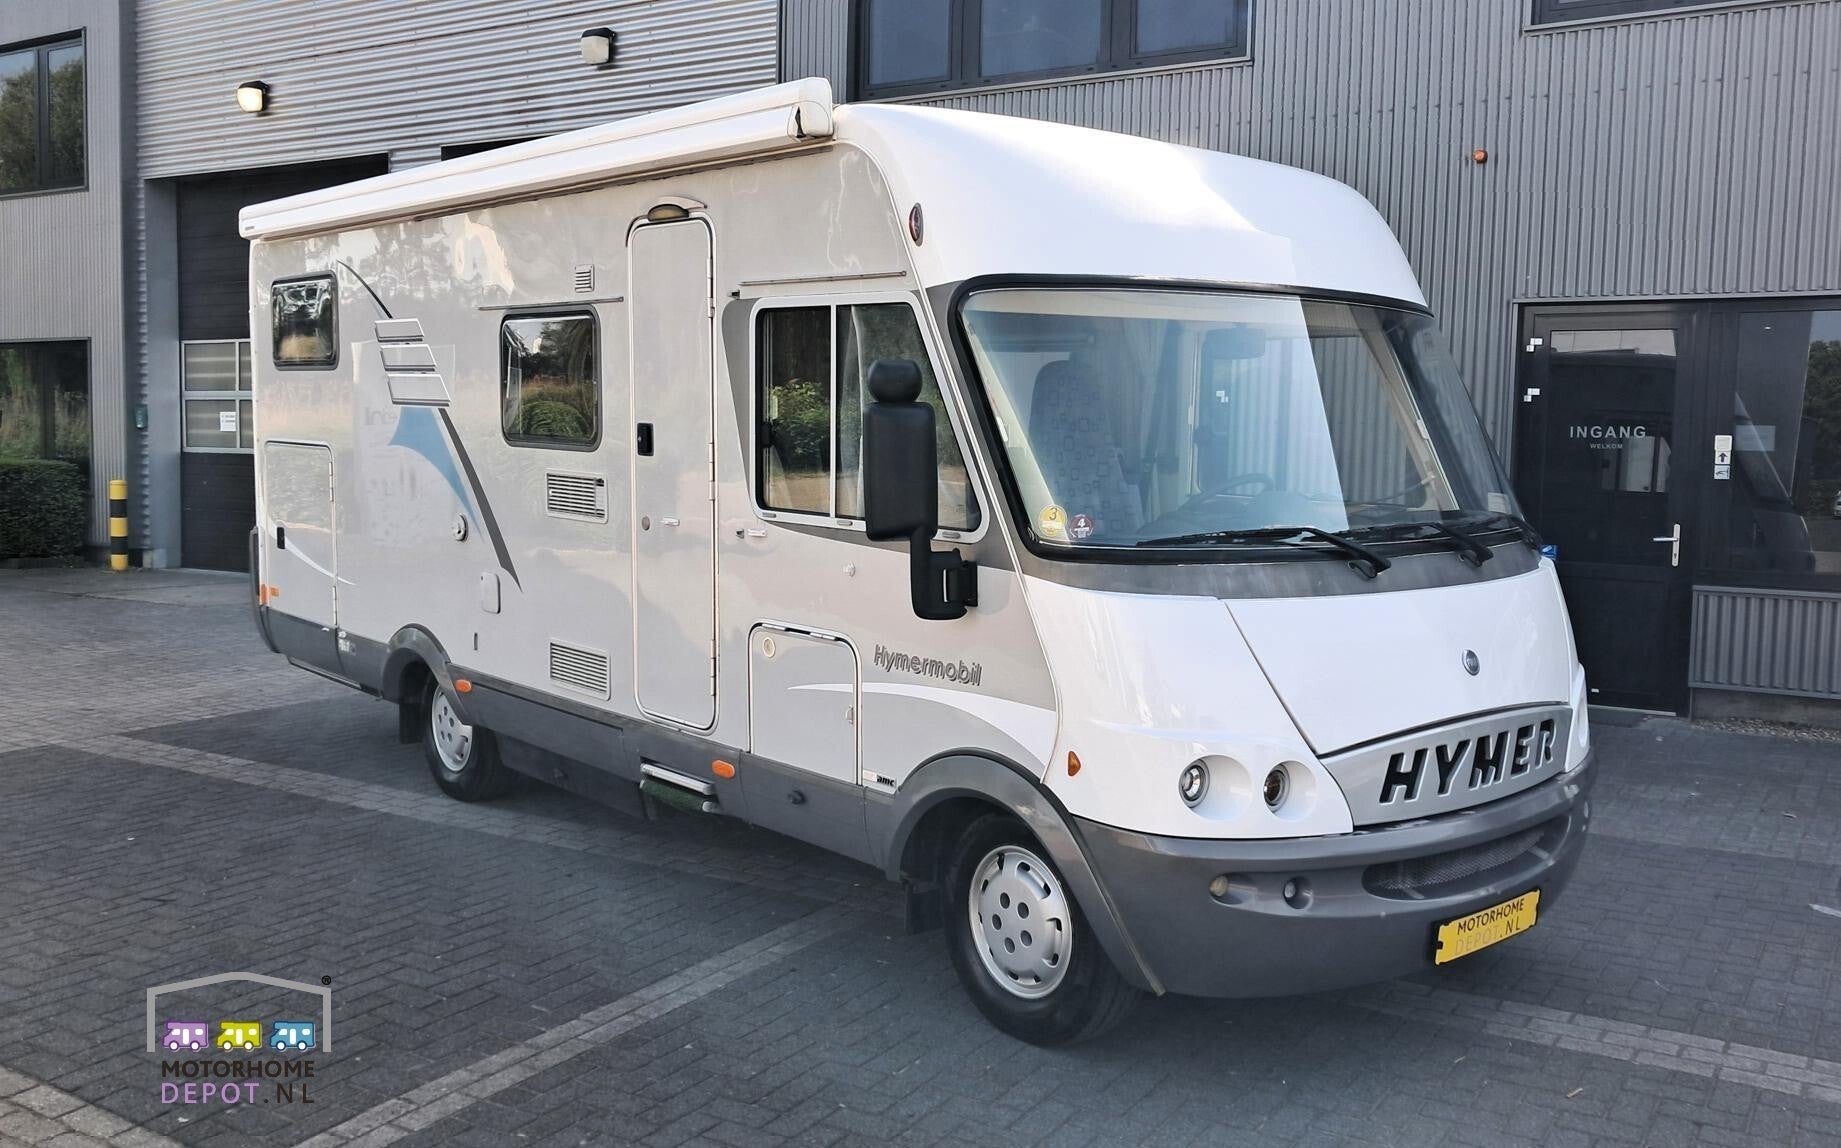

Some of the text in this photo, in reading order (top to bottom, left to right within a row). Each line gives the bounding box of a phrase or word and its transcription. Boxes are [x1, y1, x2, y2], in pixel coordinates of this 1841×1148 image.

[1569, 425, 1646, 439] INGANG
[874, 644, 982, 686] Hymermobil
[1379, 719, 1556, 805] HYMER
[1455, 916, 1520, 955] DEPOT.NL
[1457, 898, 1525, 935] MOTORHOME
